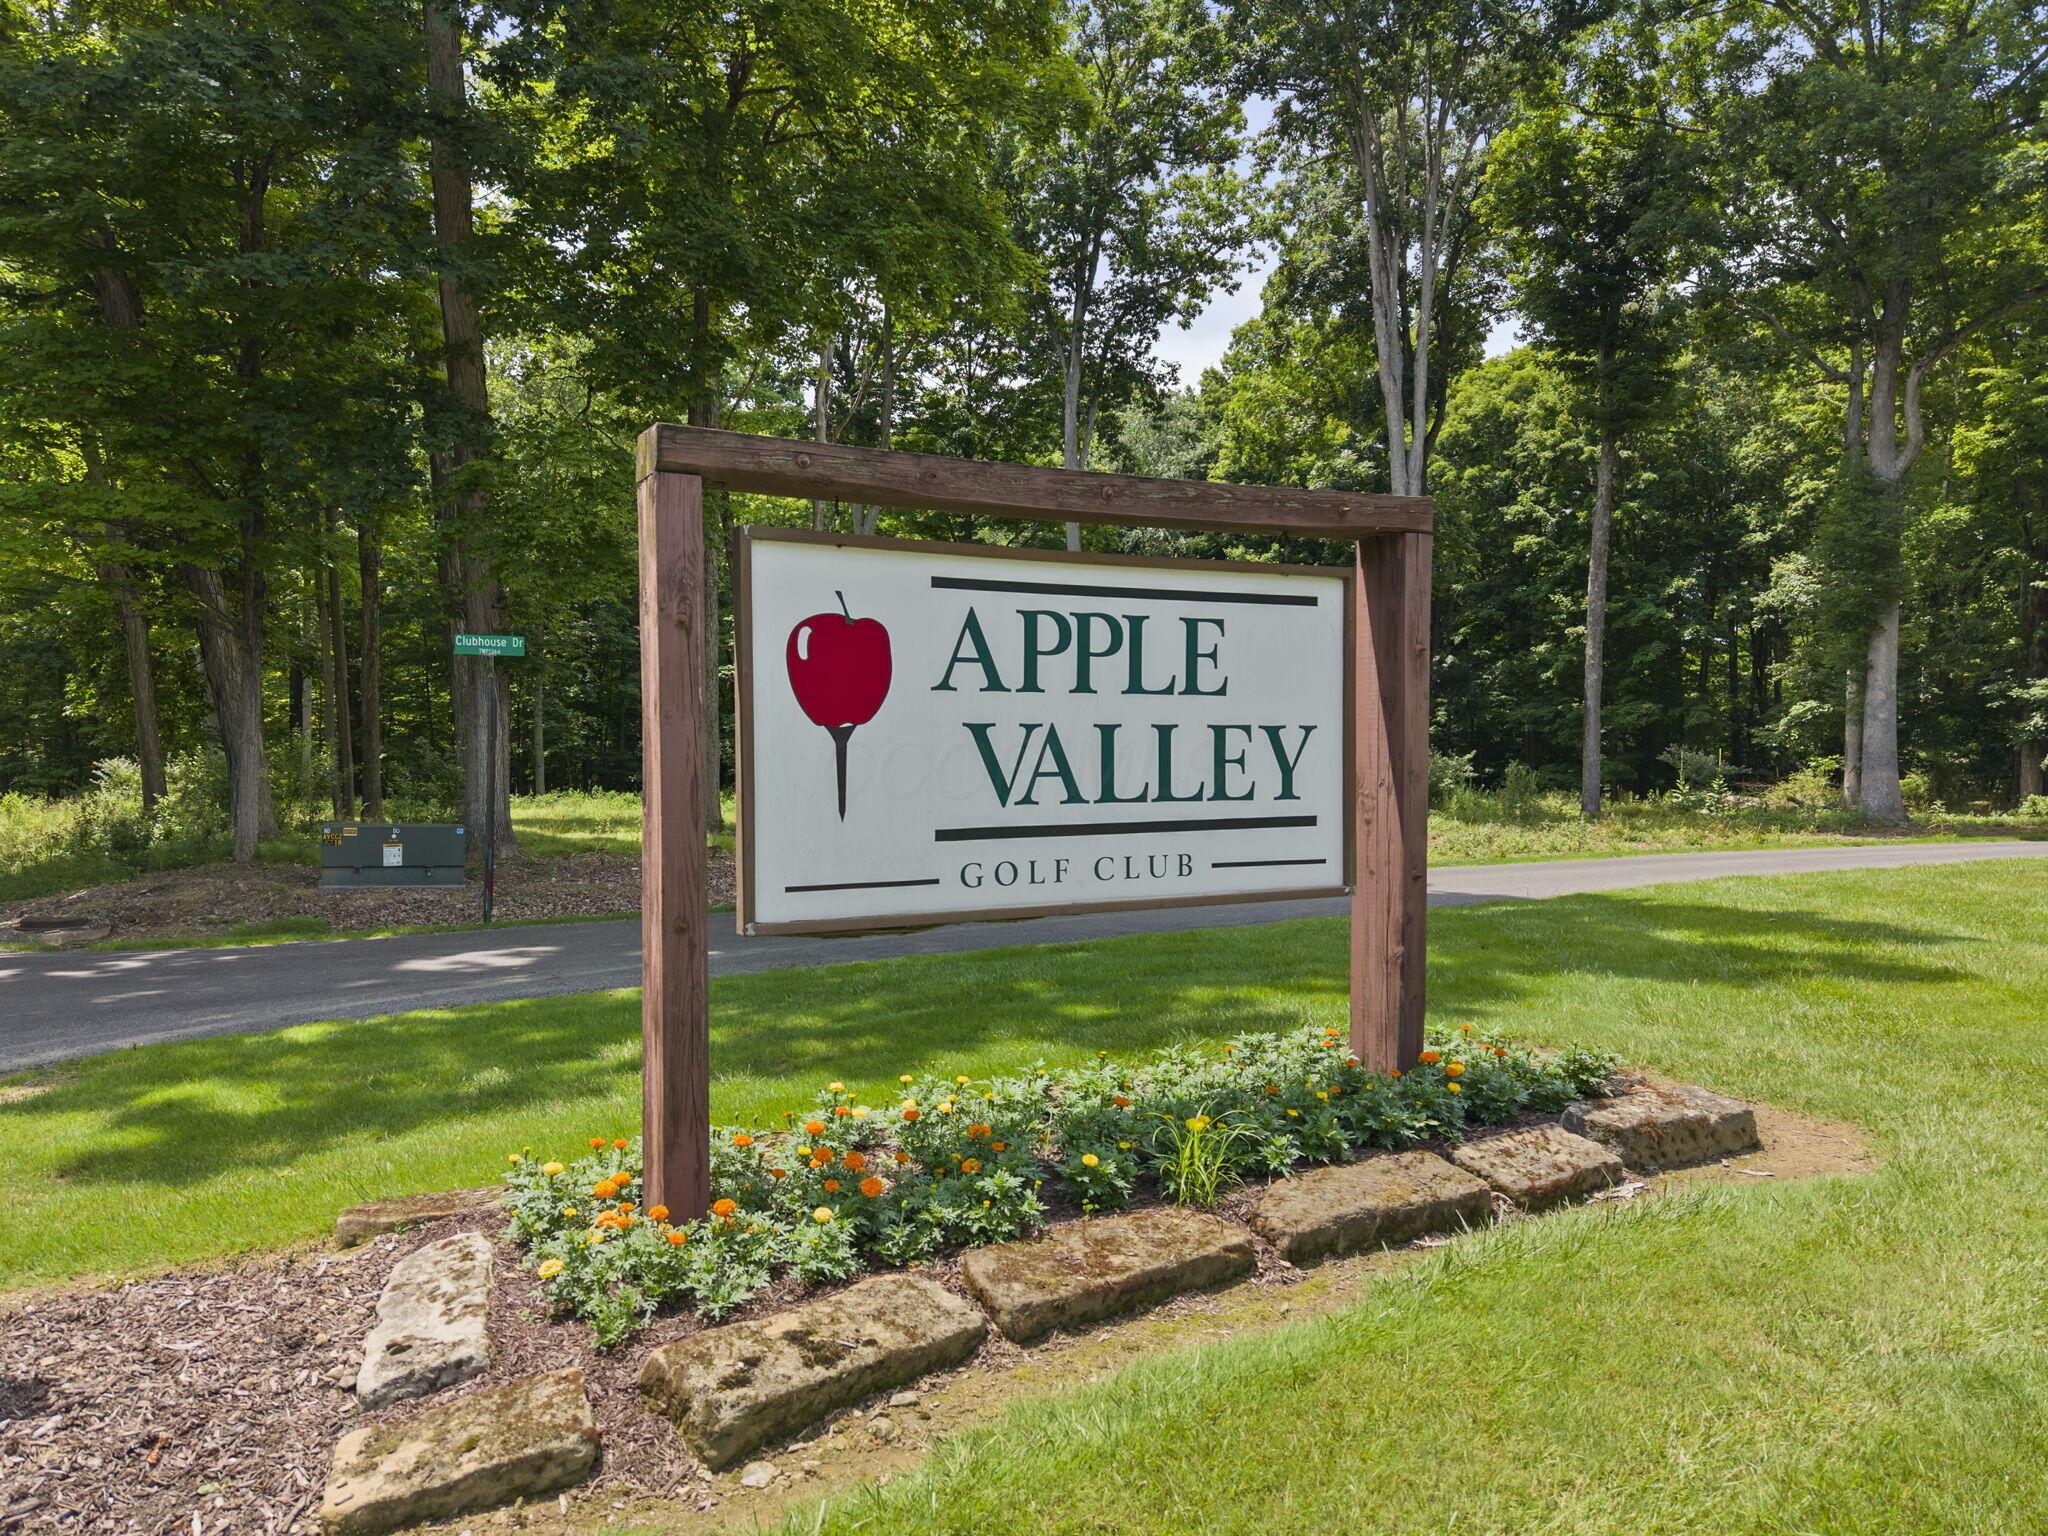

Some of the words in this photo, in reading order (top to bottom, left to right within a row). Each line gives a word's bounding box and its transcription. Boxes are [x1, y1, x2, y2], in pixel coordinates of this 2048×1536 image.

[455, 635, 507, 647] Clubhouse
[512, 637, 524, 648] Dr
[930, 606, 1229, 697] APPLE
[962, 722, 1318, 808] VALLEY
[960, 858, 1070, 888] GOLF
[1094, 853, 1193, 881] CLUB
